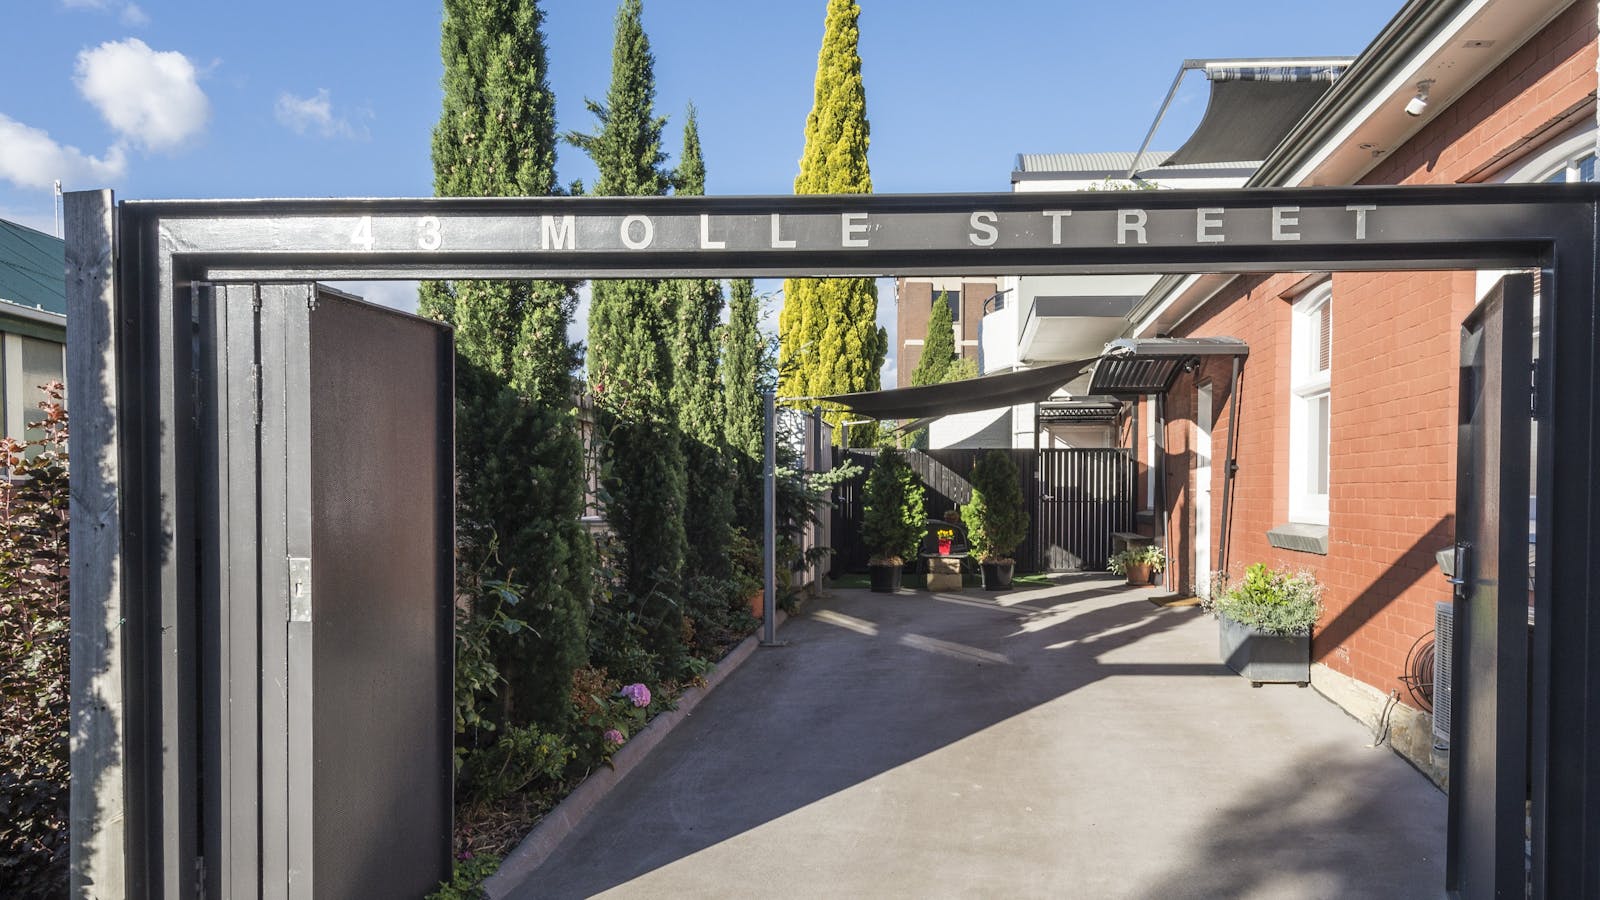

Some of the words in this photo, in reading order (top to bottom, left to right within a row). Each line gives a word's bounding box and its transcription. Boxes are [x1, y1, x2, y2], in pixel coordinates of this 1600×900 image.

[350, 215, 443, 251] 43
[541, 212, 870, 250] MOLLE
[968, 205, 1377, 247] STREET
